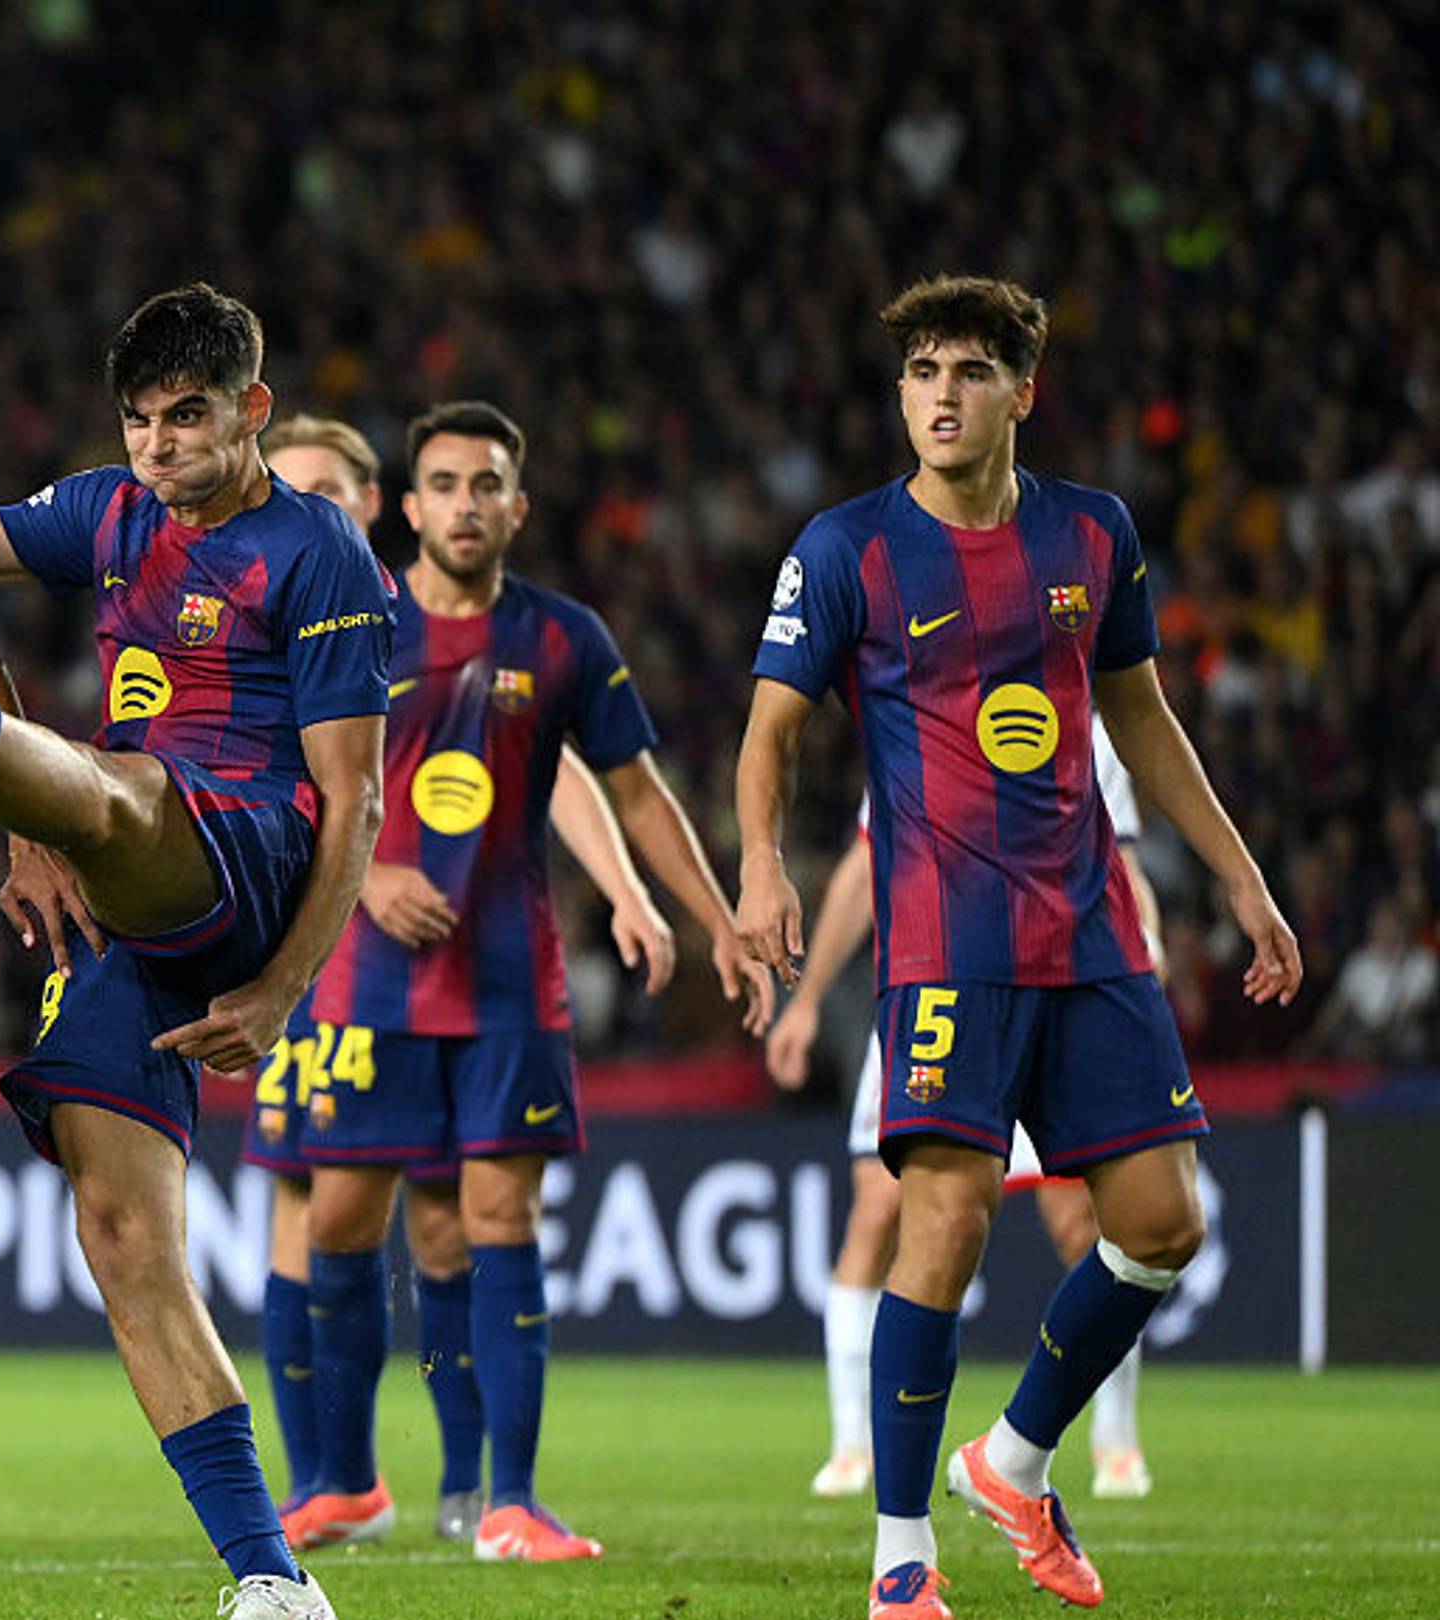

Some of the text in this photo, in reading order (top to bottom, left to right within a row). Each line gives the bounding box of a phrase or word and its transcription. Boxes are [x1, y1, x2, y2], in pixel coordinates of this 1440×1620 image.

[310, 1021, 377, 1092] 24
[910, 987, 958, 1061] 5
[256, 1036, 317, 1106] 21
